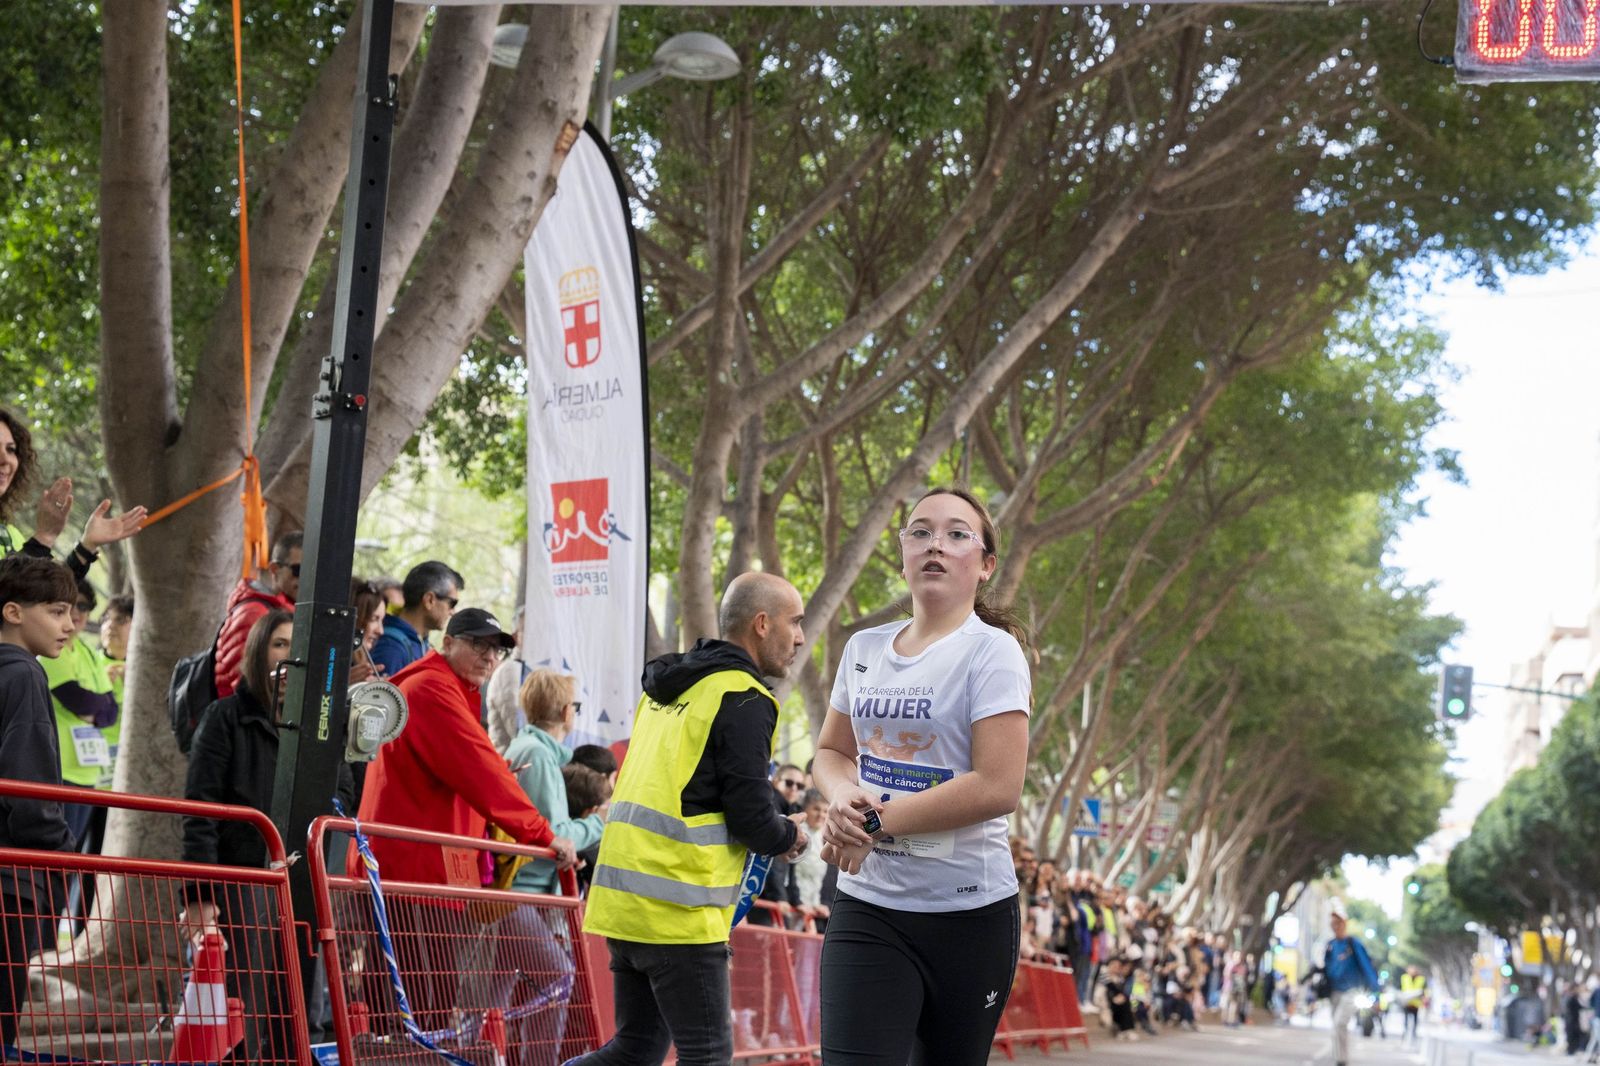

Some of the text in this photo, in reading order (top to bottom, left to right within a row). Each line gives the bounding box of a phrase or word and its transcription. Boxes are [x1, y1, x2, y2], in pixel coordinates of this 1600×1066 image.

[857, 686, 934, 696] XI CARRERA DE LA
[852, 697, 932, 720] MUJER
[318, 695, 330, 741] FENIX
[864, 771, 928, 789] contra el cáncer
[892, 767, 904, 775] en
[906, 769, 942, 780] marcha
